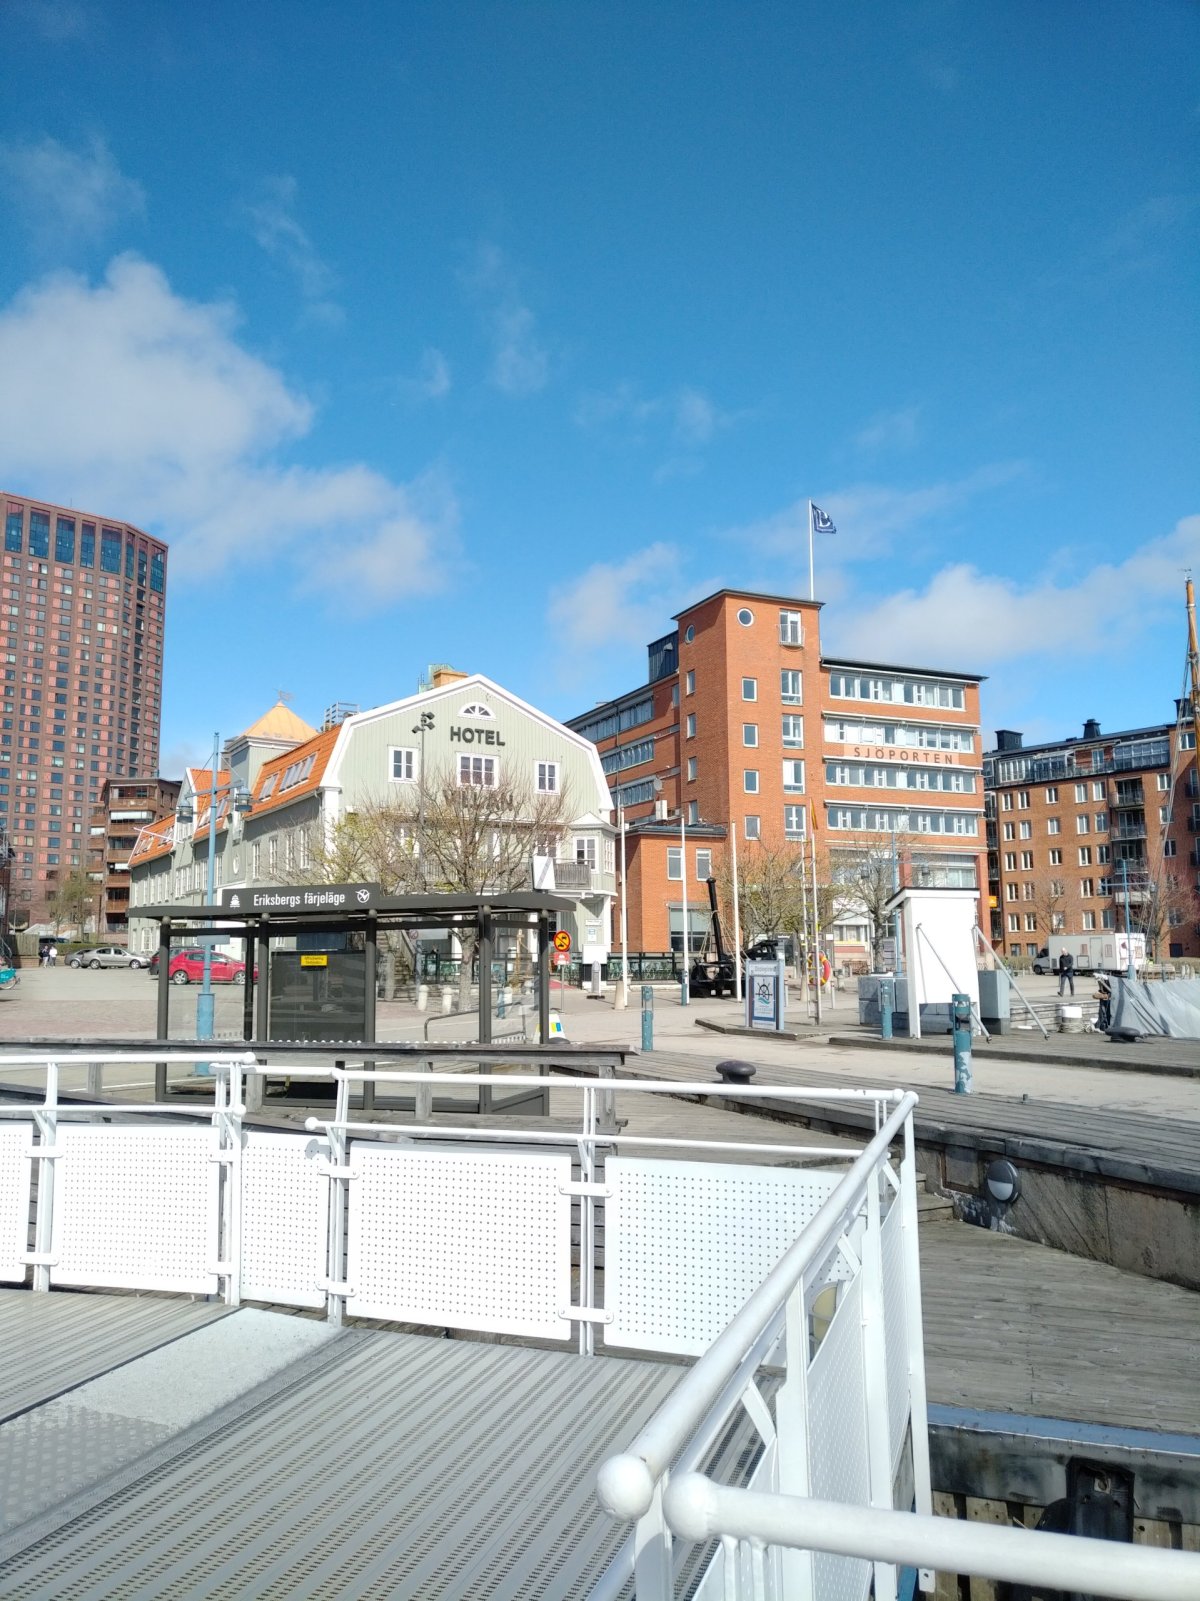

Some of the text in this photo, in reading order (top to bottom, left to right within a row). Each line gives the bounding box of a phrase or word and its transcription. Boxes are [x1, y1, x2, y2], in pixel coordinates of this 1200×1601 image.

[450, 726, 506, 746] HOTEL
[854, 747, 953, 764] SJÖPORTEN
[253, 892, 345, 908] Eriksbergs färjeläge
